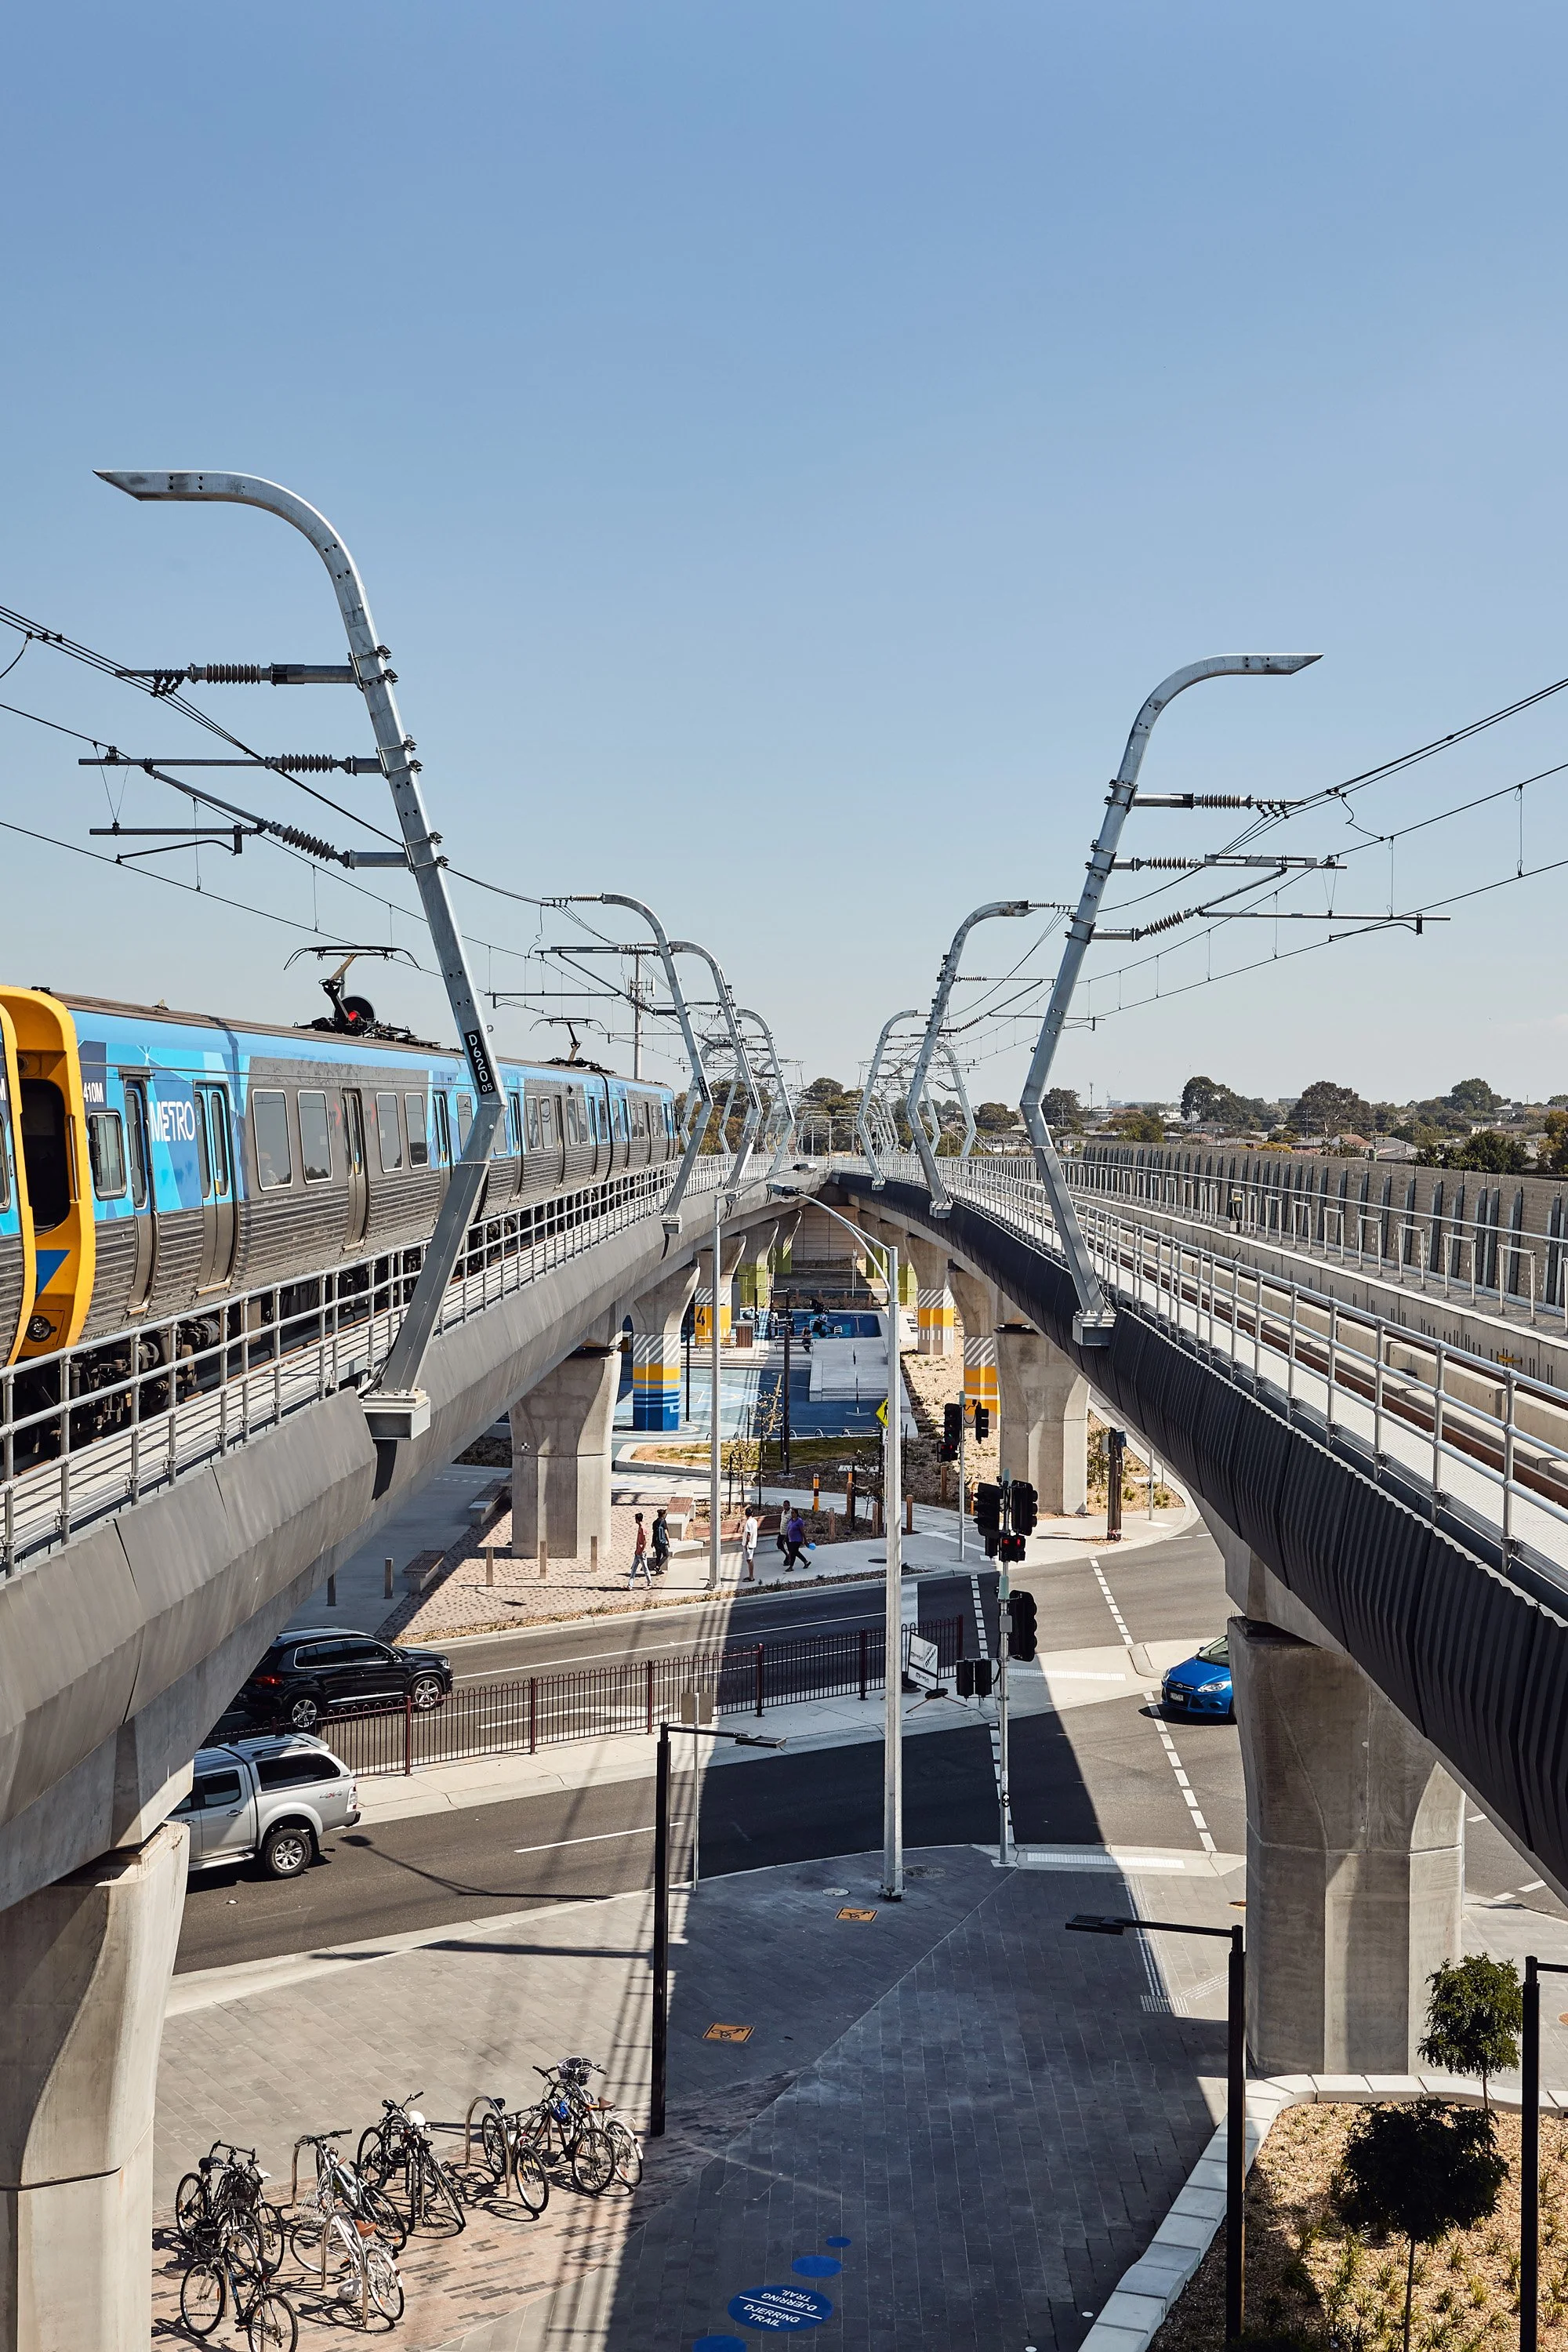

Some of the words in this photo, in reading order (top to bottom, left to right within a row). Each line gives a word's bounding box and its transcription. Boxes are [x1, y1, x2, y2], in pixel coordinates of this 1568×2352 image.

[468, 1034, 488, 1082] D620
[83, 1082, 103, 1102] 410M
[481, 1083, 493, 1092] 05
[149, 1101, 195, 1142] METRO
[696, 1307, 706, 1326] 4
[761, 2293, 818, 2311] DJERRING
[782, 2289, 811, 2302] TRAIL
[743, 2304, 800, 2323] DJERRING
[749, 2313, 779, 2327] TRAIL
